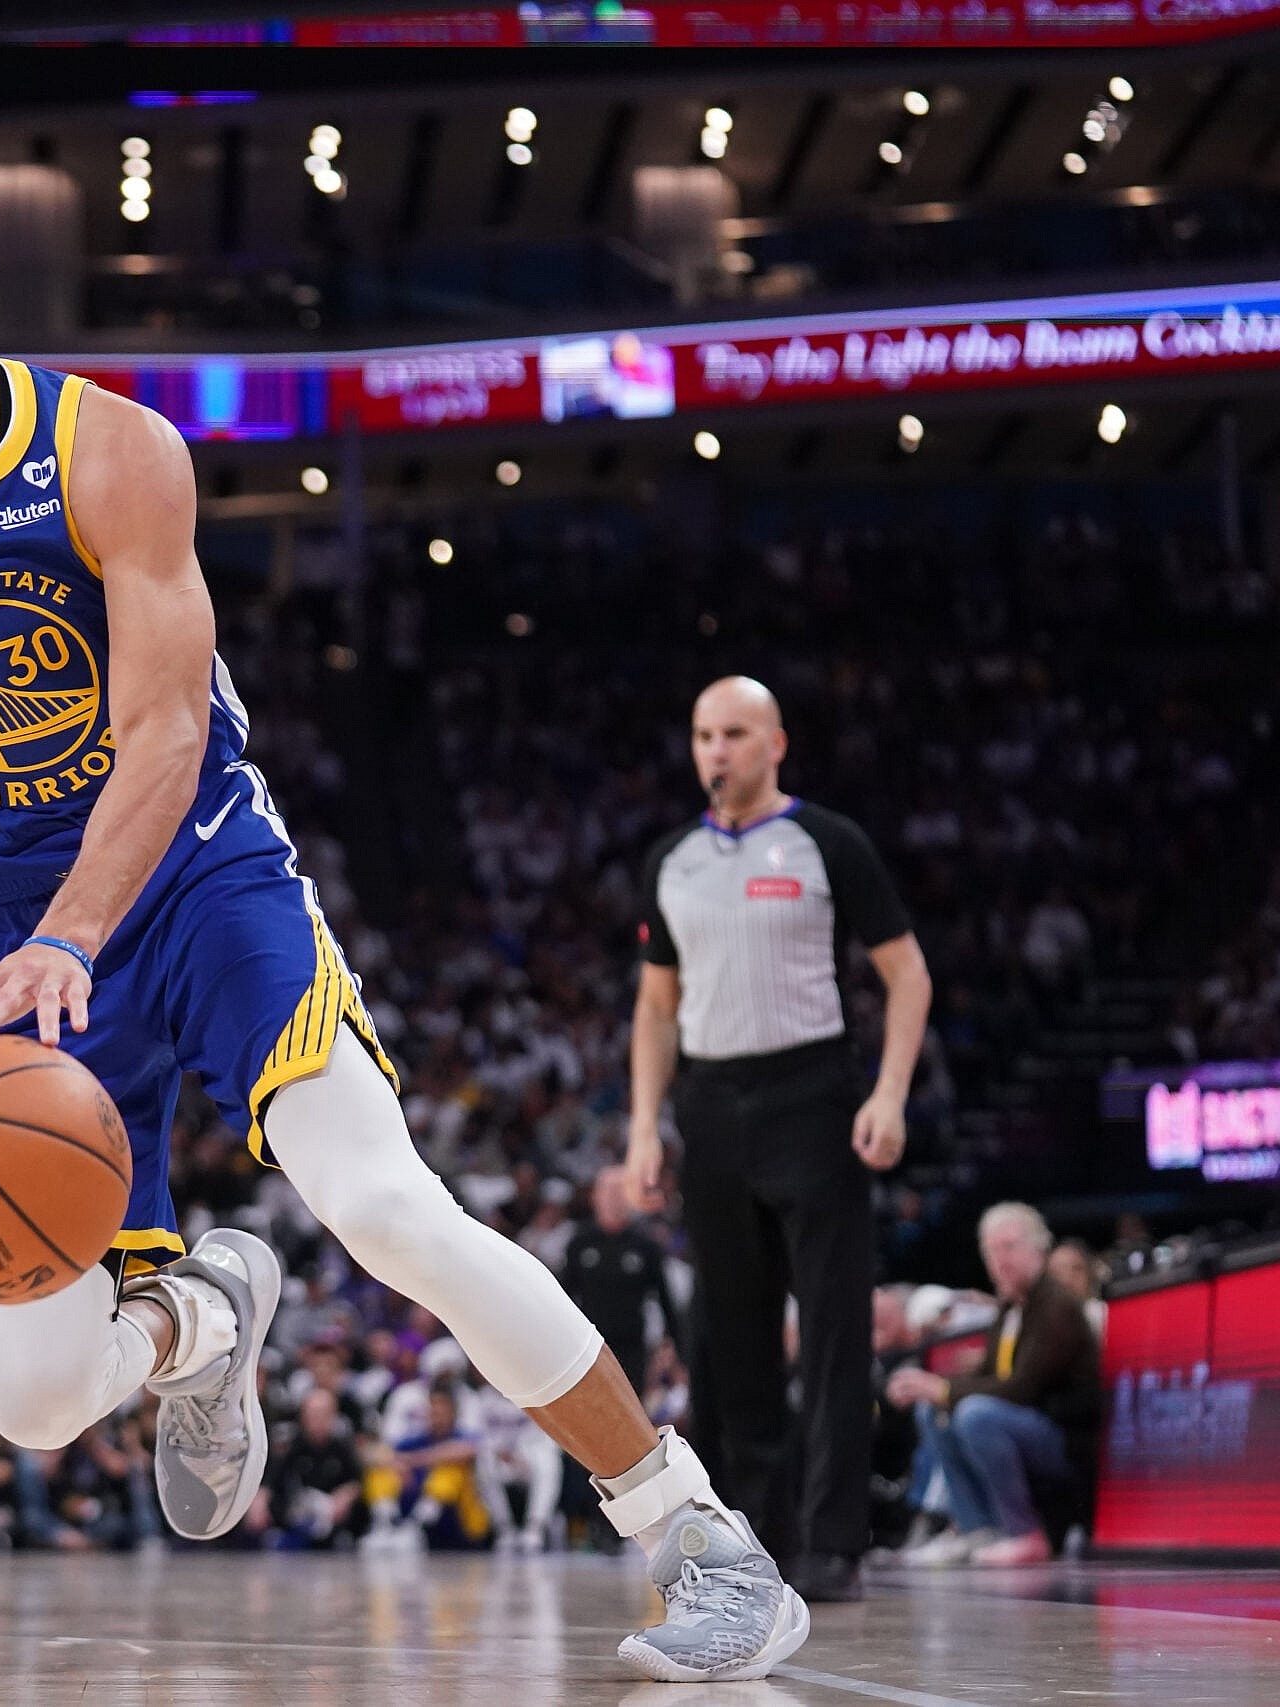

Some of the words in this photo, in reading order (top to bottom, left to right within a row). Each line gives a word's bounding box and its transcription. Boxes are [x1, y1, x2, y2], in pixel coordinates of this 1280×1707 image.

[773, 335, 839, 385] the
[843, 327, 951, 390] Light
[951, 322, 1021, 373] the
[1022, 319, 1138, 369] Beam
[31, 464, 52, 482] DM
